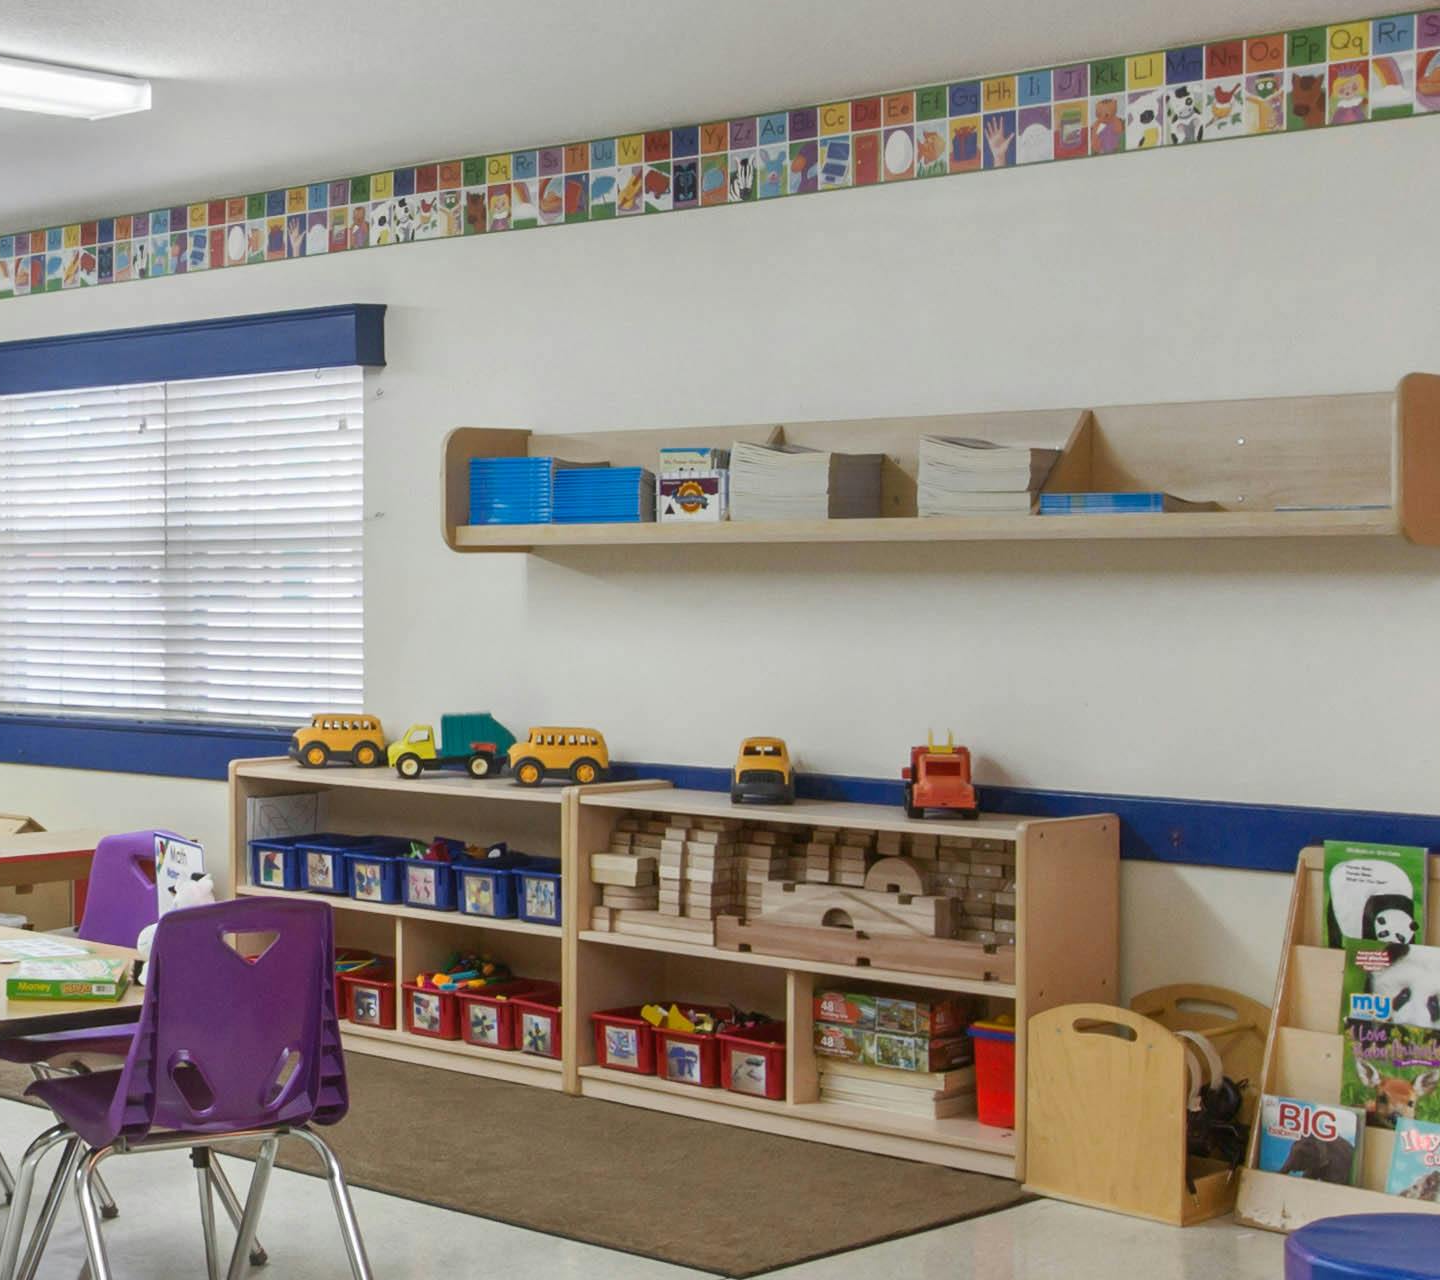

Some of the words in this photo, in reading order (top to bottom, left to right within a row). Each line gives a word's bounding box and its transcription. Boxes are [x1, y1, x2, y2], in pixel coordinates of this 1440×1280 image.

[761, 119, 786, 138] Aa
[823, 108, 846, 129] Cc
[986, 81, 1012, 102] Hh
[1248, 40, 1280, 61] Oo
[1290, 33, 1321, 65] Pp
[1329, 27, 1370, 58] Qq
[1377, 21, 1409, 44] Rr
[15, 981, 51, 993] Money
[820, 999, 834, 1011] 48
[1360, 1024, 1388, 1041] Love
[820, 1035, 834, 1047] 48
[1279, 1103, 1337, 1140] BIG
